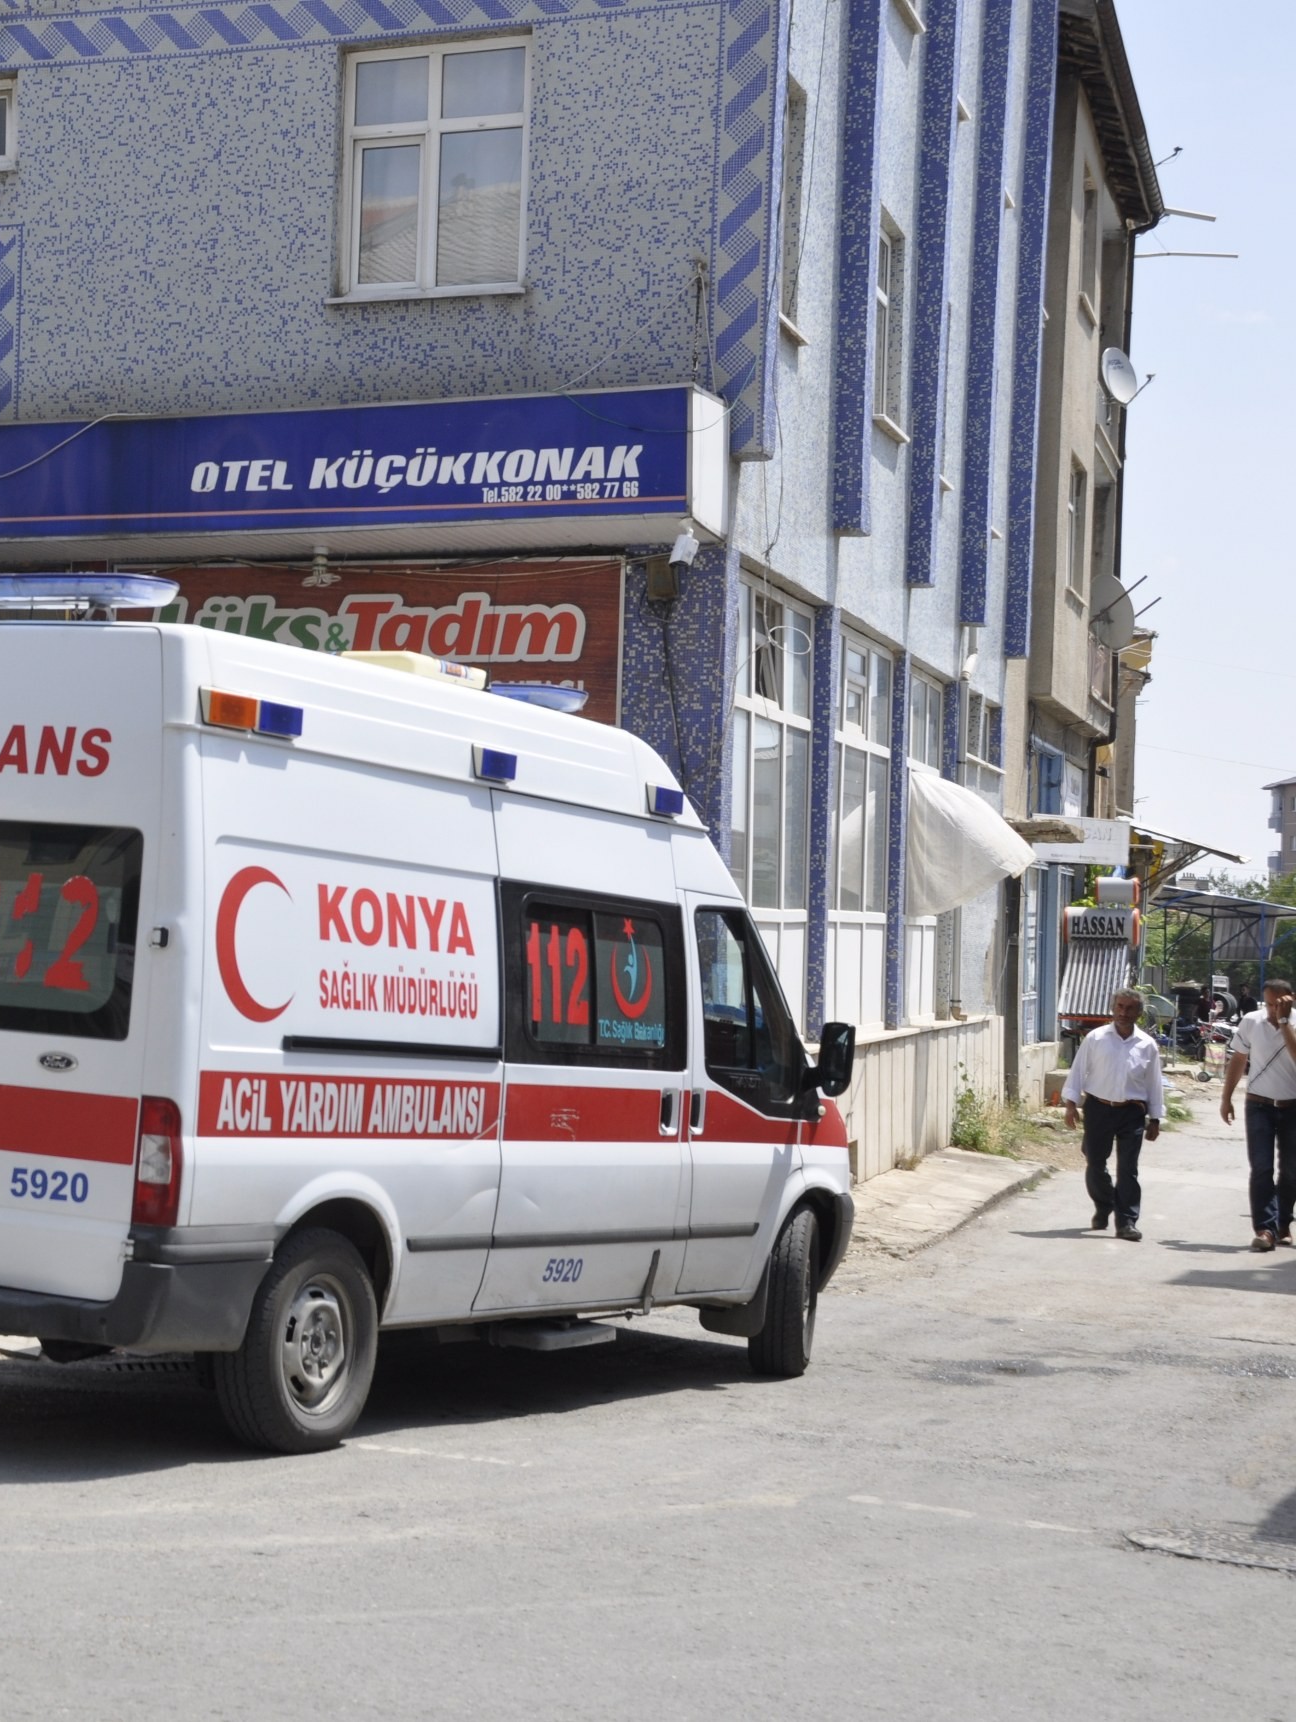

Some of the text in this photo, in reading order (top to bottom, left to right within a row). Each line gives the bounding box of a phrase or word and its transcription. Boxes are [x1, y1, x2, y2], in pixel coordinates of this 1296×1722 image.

[190, 444, 643, 494] OTEL KÜÇÜKKONAK
[526, 485, 543, 501] 22
[602, 482, 620, 499] 77
[622, 480, 639, 498] 66
[342, 600, 578, 656] Tadım
[317, 883, 476, 957] KONYA
[1071, 915, 1126, 936] HASSAN
[319, 960, 478, 1021] SAĞLIK MÜDÜRLÜĞÜ
[526, 922, 589, 1025] 112
[280, 1080, 365, 1133] YARDIM
[367, 1083, 486, 1135] AMBULANSI
[10, 1167, 89, 1203] 5920
[542, 1258, 584, 1283] 5920
